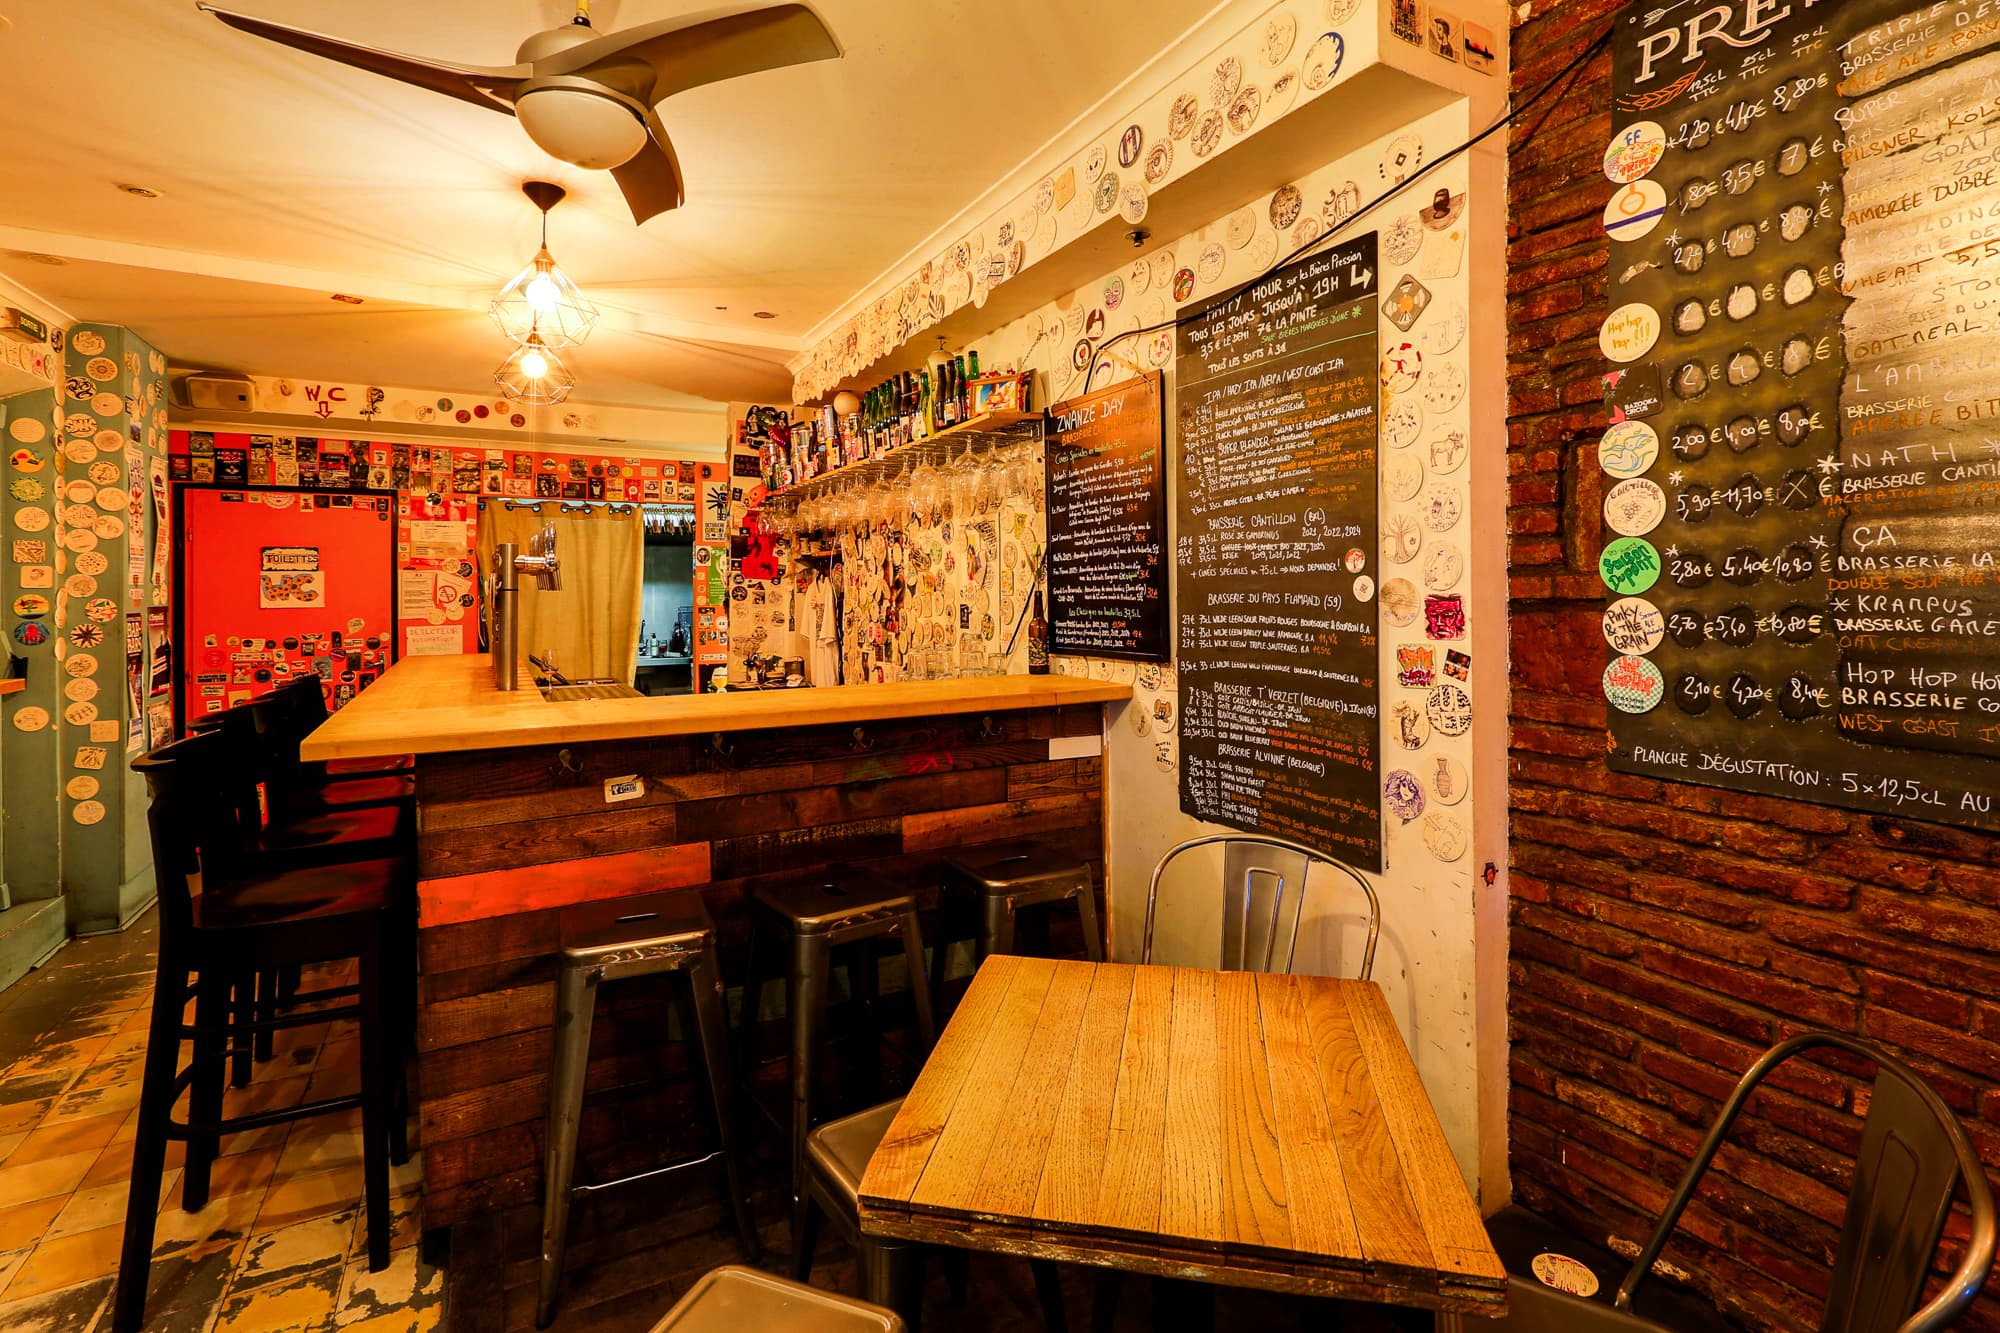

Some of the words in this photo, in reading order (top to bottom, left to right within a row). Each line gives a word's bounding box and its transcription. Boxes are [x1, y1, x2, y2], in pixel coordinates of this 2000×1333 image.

[1688, 85, 1720, 102] TTC
[1738, 64, 1769, 81] TTC
[1791, 38, 1824, 59] TTC
[1842, 127, 1926, 166] PILSNER
[1252, 278, 1283, 303] HOUR
[1286, 275, 1298, 288] sur
[1300, 268, 1309, 280] les
[1309, 261, 1330, 277] Bières
[1331, 251, 1362, 270] Pression
[1188, 327, 1209, 343] TOUS
[1211, 320, 1225, 335] LES
[1228, 309, 1255, 330] JOURS
[1312, 275, 1339, 300] 19H
[1275, 316, 1287, 330] LA
[1289, 304, 1318, 327] PINTE
[1208, 357, 1227, 374] TOUS
[1229, 356, 1240, 368] LES
[1242, 347, 1264, 364] SOFTS
[1057, 404, 1097, 434] ZWANZE
[1100, 394, 1125, 419] DAY
[1847, 395, 1934, 419] BRASSERIE
[1218, 442, 1239, 456] SUPER
[1239, 435, 1270, 452] BLENDER
[1842, 471, 1927, 494] BRASSERIE
[1207, 515, 1245, 530] BRASSERIE
[1250, 512, 1297, 527] CANTILLON
[1852, 525, 1897, 553] ÇA
[264, 551, 319, 565] TOILETTES
[1837, 554, 1957, 571] BRASSERIE
[1827, 574, 1890, 591] DOUBLE
[1207, 592, 1245, 606] BRASSERIE
[1247, 592, 1260, 604] DU
[1261, 591, 1281, 605] PAYS
[1284, 592, 1321, 607] FLAMAND
[1323, 594, 1342, 612] (59)
[1833, 616, 1925, 633] BRASSERIE
[1614, 630, 1650, 651] GRAIN
[1847, 661, 1896, 685] HOP
[1909, 667, 1958, 689] HOP
[1213, 681, 1252, 697] BRASSERIE
[1267, 687, 1300, 705] VERZET
[1841, 686, 1968, 710] BRASSERIE
[1839, 713, 1894, 733] WEST
[1903, 718, 1961, 739] COAST
[1218, 743, 1252, 759] BRASSERIE
[1254, 749, 1286, 766] ALVINNE
[1287, 755, 1325, 778] (BELGIQUE)
[1634, 745, 1689, 768] PLANCHE
[1960, 791, 1991, 812] AU
